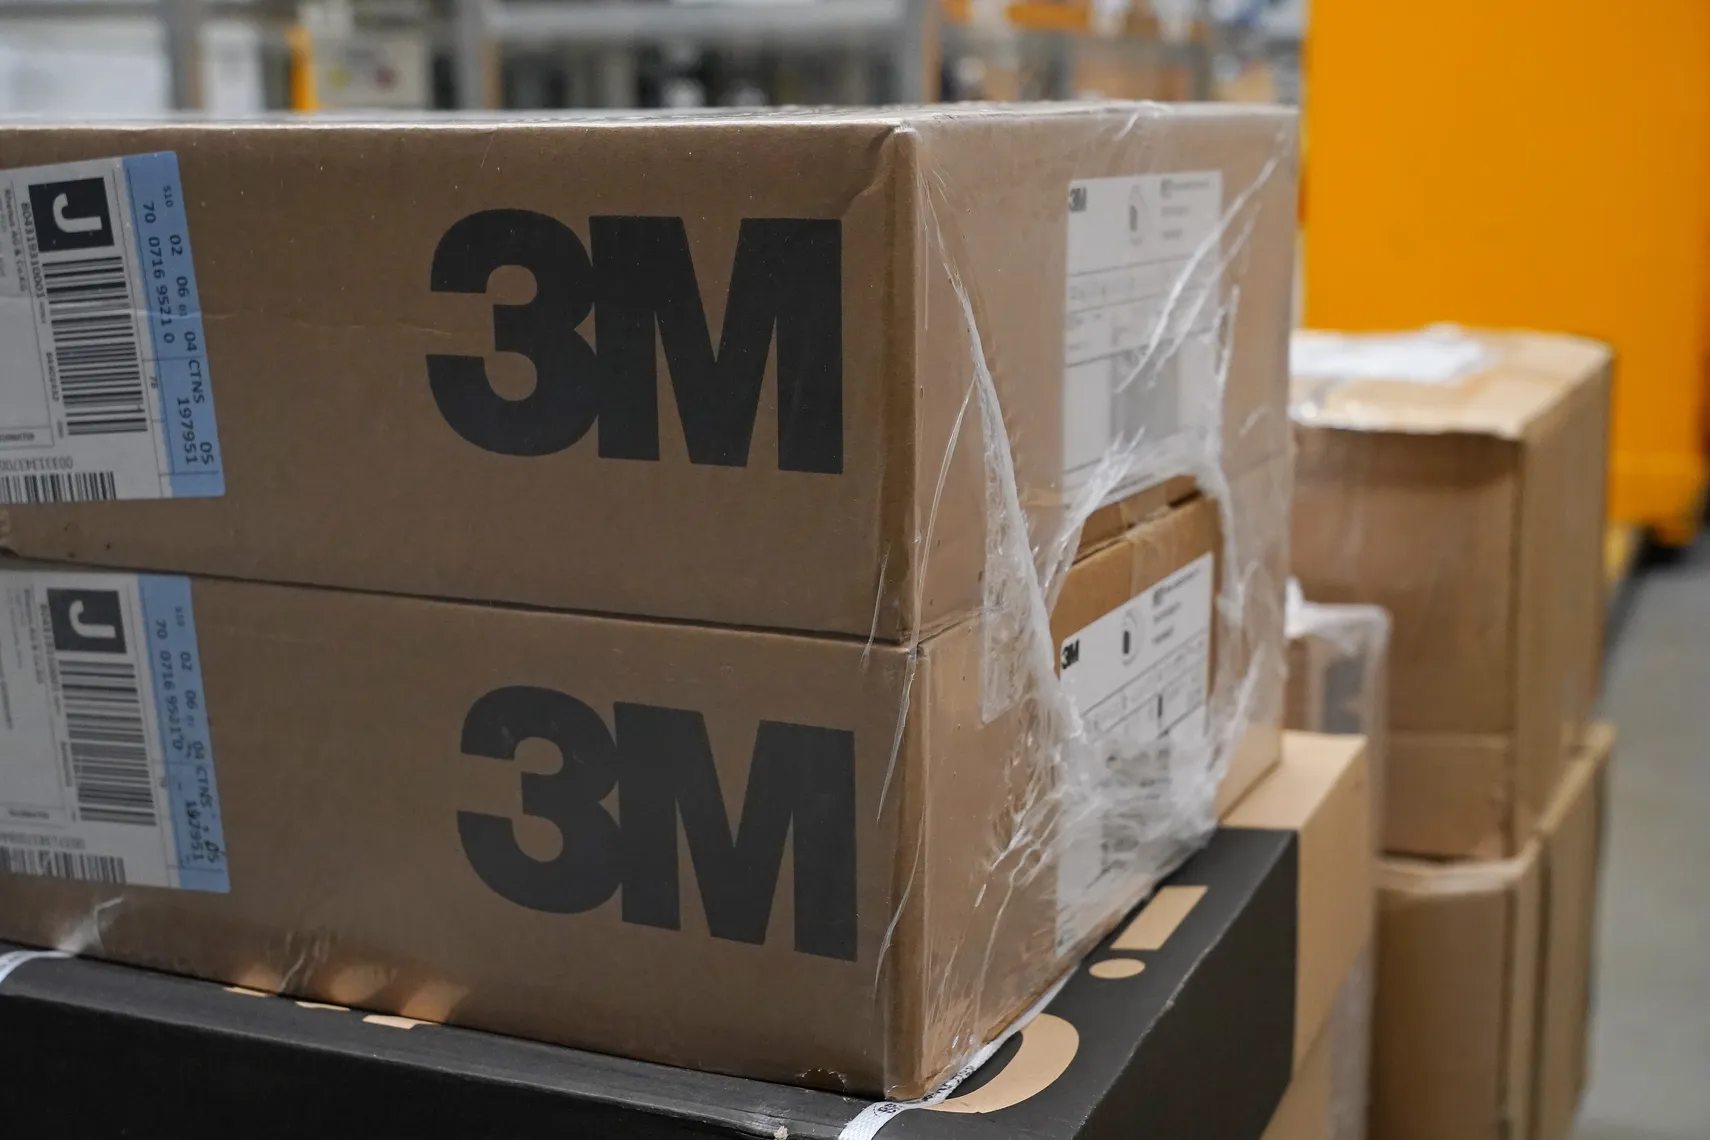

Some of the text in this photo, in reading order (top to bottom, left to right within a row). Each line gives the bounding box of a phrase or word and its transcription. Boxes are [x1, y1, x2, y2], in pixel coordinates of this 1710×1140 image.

[169, 234, 183, 257] 02
[143, 201, 175, 344] 70 0716 9521 0
[176, 276, 190, 298] 06
[184, 331, 198, 352] 04
[426, 209, 843, 474] 3M
[188, 359, 205, 404] CTNS
[177, 397, 198, 465] 197951
[200, 441, 214, 466] 05
[155, 620, 168, 640] 70
[180, 651, 193, 671] 02
[1062, 639, 1079, 670] 3M
[160, 651, 175, 690] 0716
[185, 689, 198, 710] 06
[167, 695, 183, 736] 9521
[192, 740, 205, 760] 04
[196, 766, 213, 808] CTNS
[185, 800, 204, 862] 197951
[457, 686, 857, 962] 3M
[204, 841, 220, 864] 05
